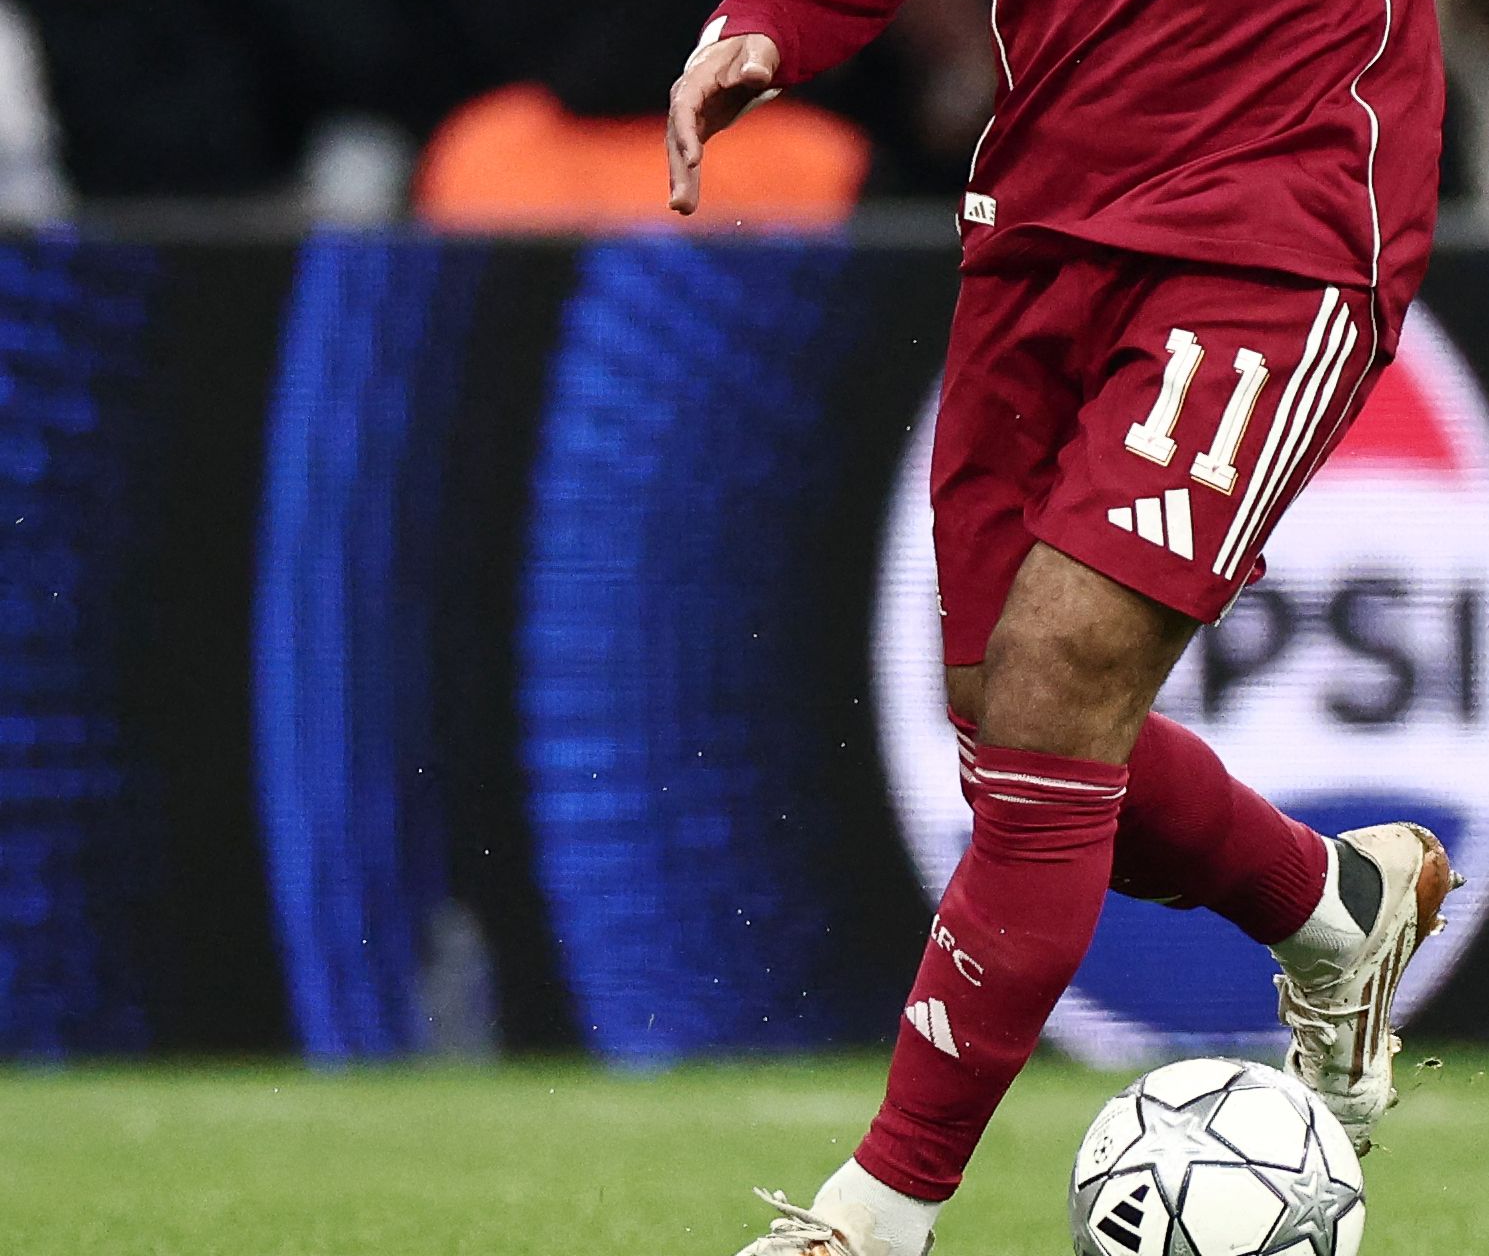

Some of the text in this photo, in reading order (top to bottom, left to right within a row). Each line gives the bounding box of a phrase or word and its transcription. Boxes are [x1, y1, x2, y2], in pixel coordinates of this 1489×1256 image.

[1124, 327, 1270, 496] 11
[1202, 578, 1486, 728] PSI
[931, 913, 984, 987] LFC
